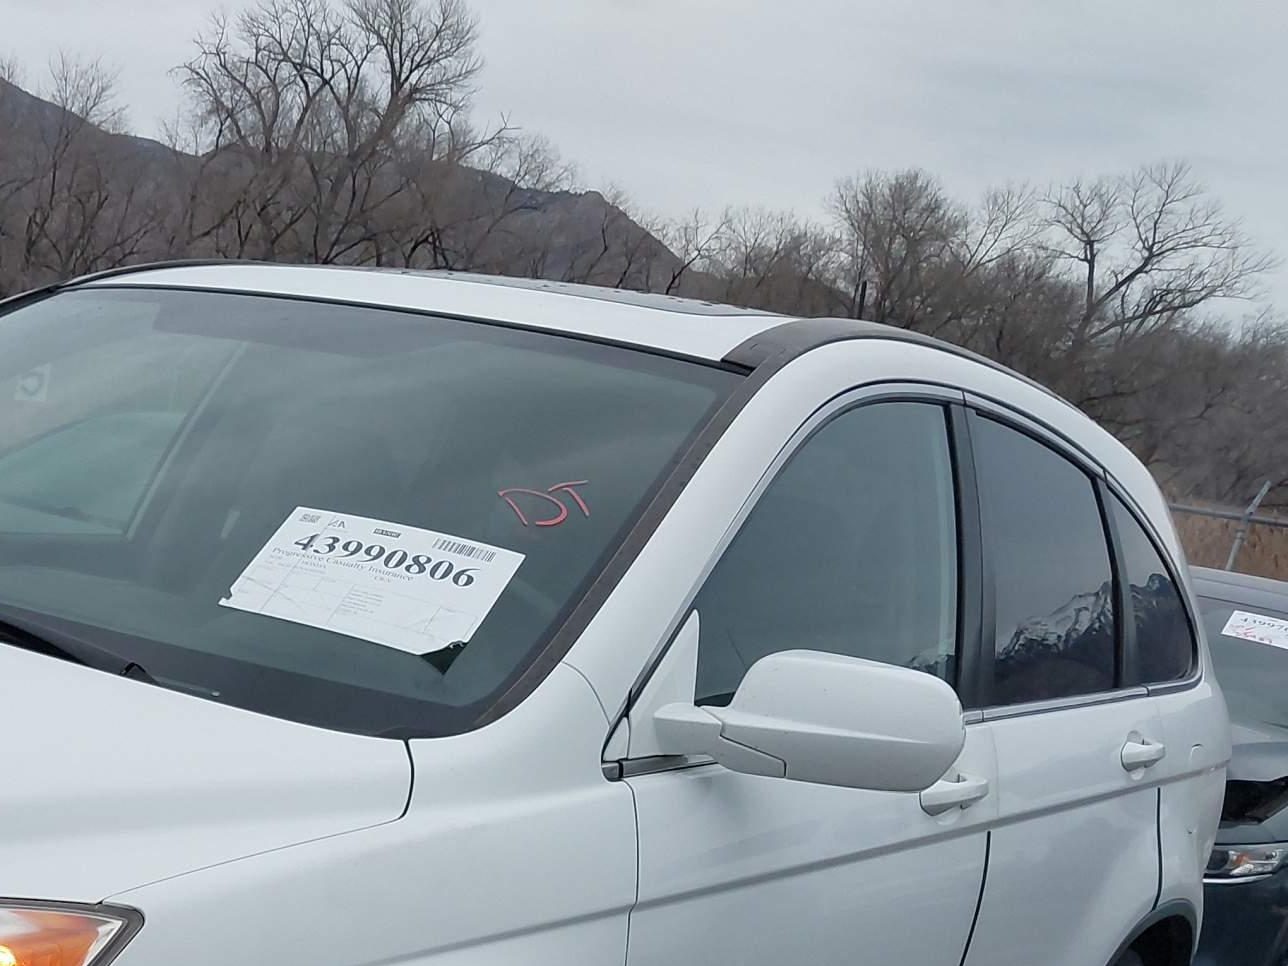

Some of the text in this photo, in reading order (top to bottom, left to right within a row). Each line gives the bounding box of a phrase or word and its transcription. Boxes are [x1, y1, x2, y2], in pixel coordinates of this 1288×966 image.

[272, 547, 325, 563] Progressive
[326, 557, 366, 571] Casualty
[368, 565, 414, 582] Insurance
[294, 533, 480, 588] 43990806
